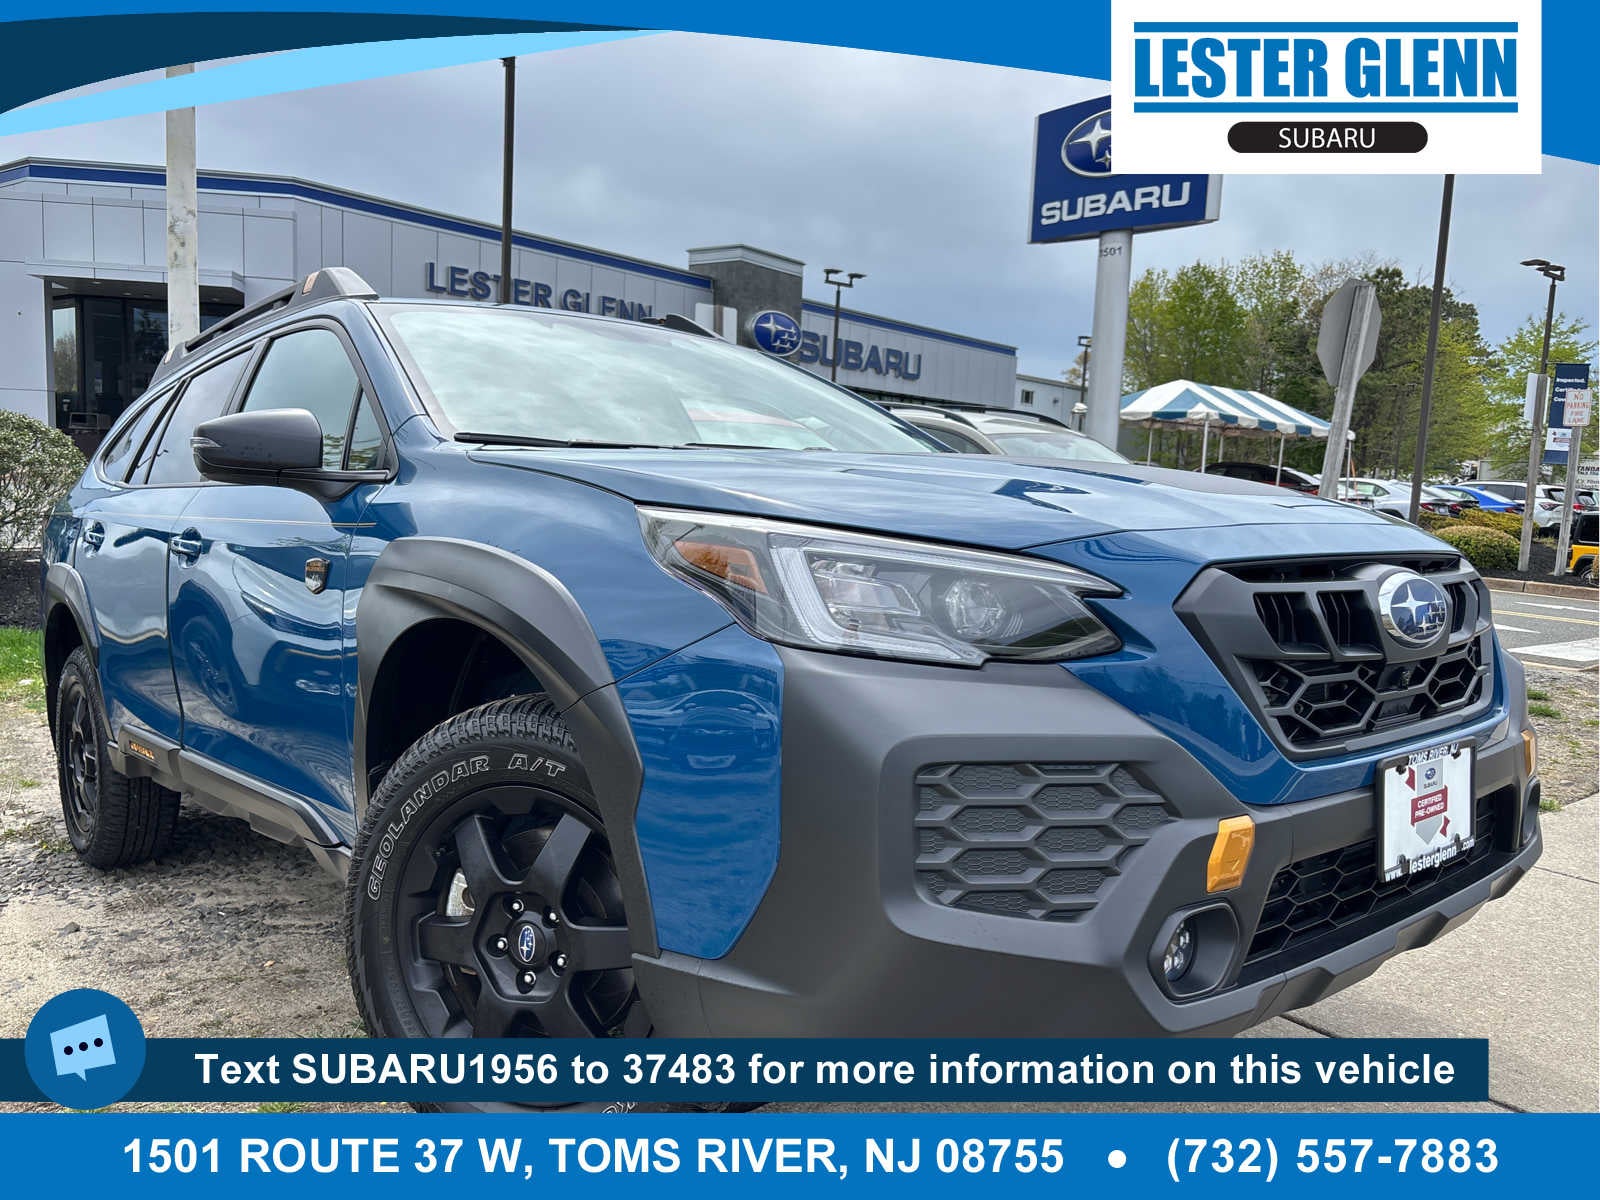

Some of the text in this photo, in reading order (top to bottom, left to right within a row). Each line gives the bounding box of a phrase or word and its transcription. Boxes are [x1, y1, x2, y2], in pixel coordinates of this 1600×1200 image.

[1040, 181, 1191, 226] SUBARU
[799, 330, 922, 381] SUBARU
[1574, 391, 1585, 401] NO
[1408, 751, 1428, 766] TOMS
[1415, 802, 1445, 818] PRE-OWNED
[1418, 794, 1442, 808] CERTIFIED
[367, 753, 566, 903] GEOLANDAR A/T
[1409, 845, 1457, 874] lesterglenn
